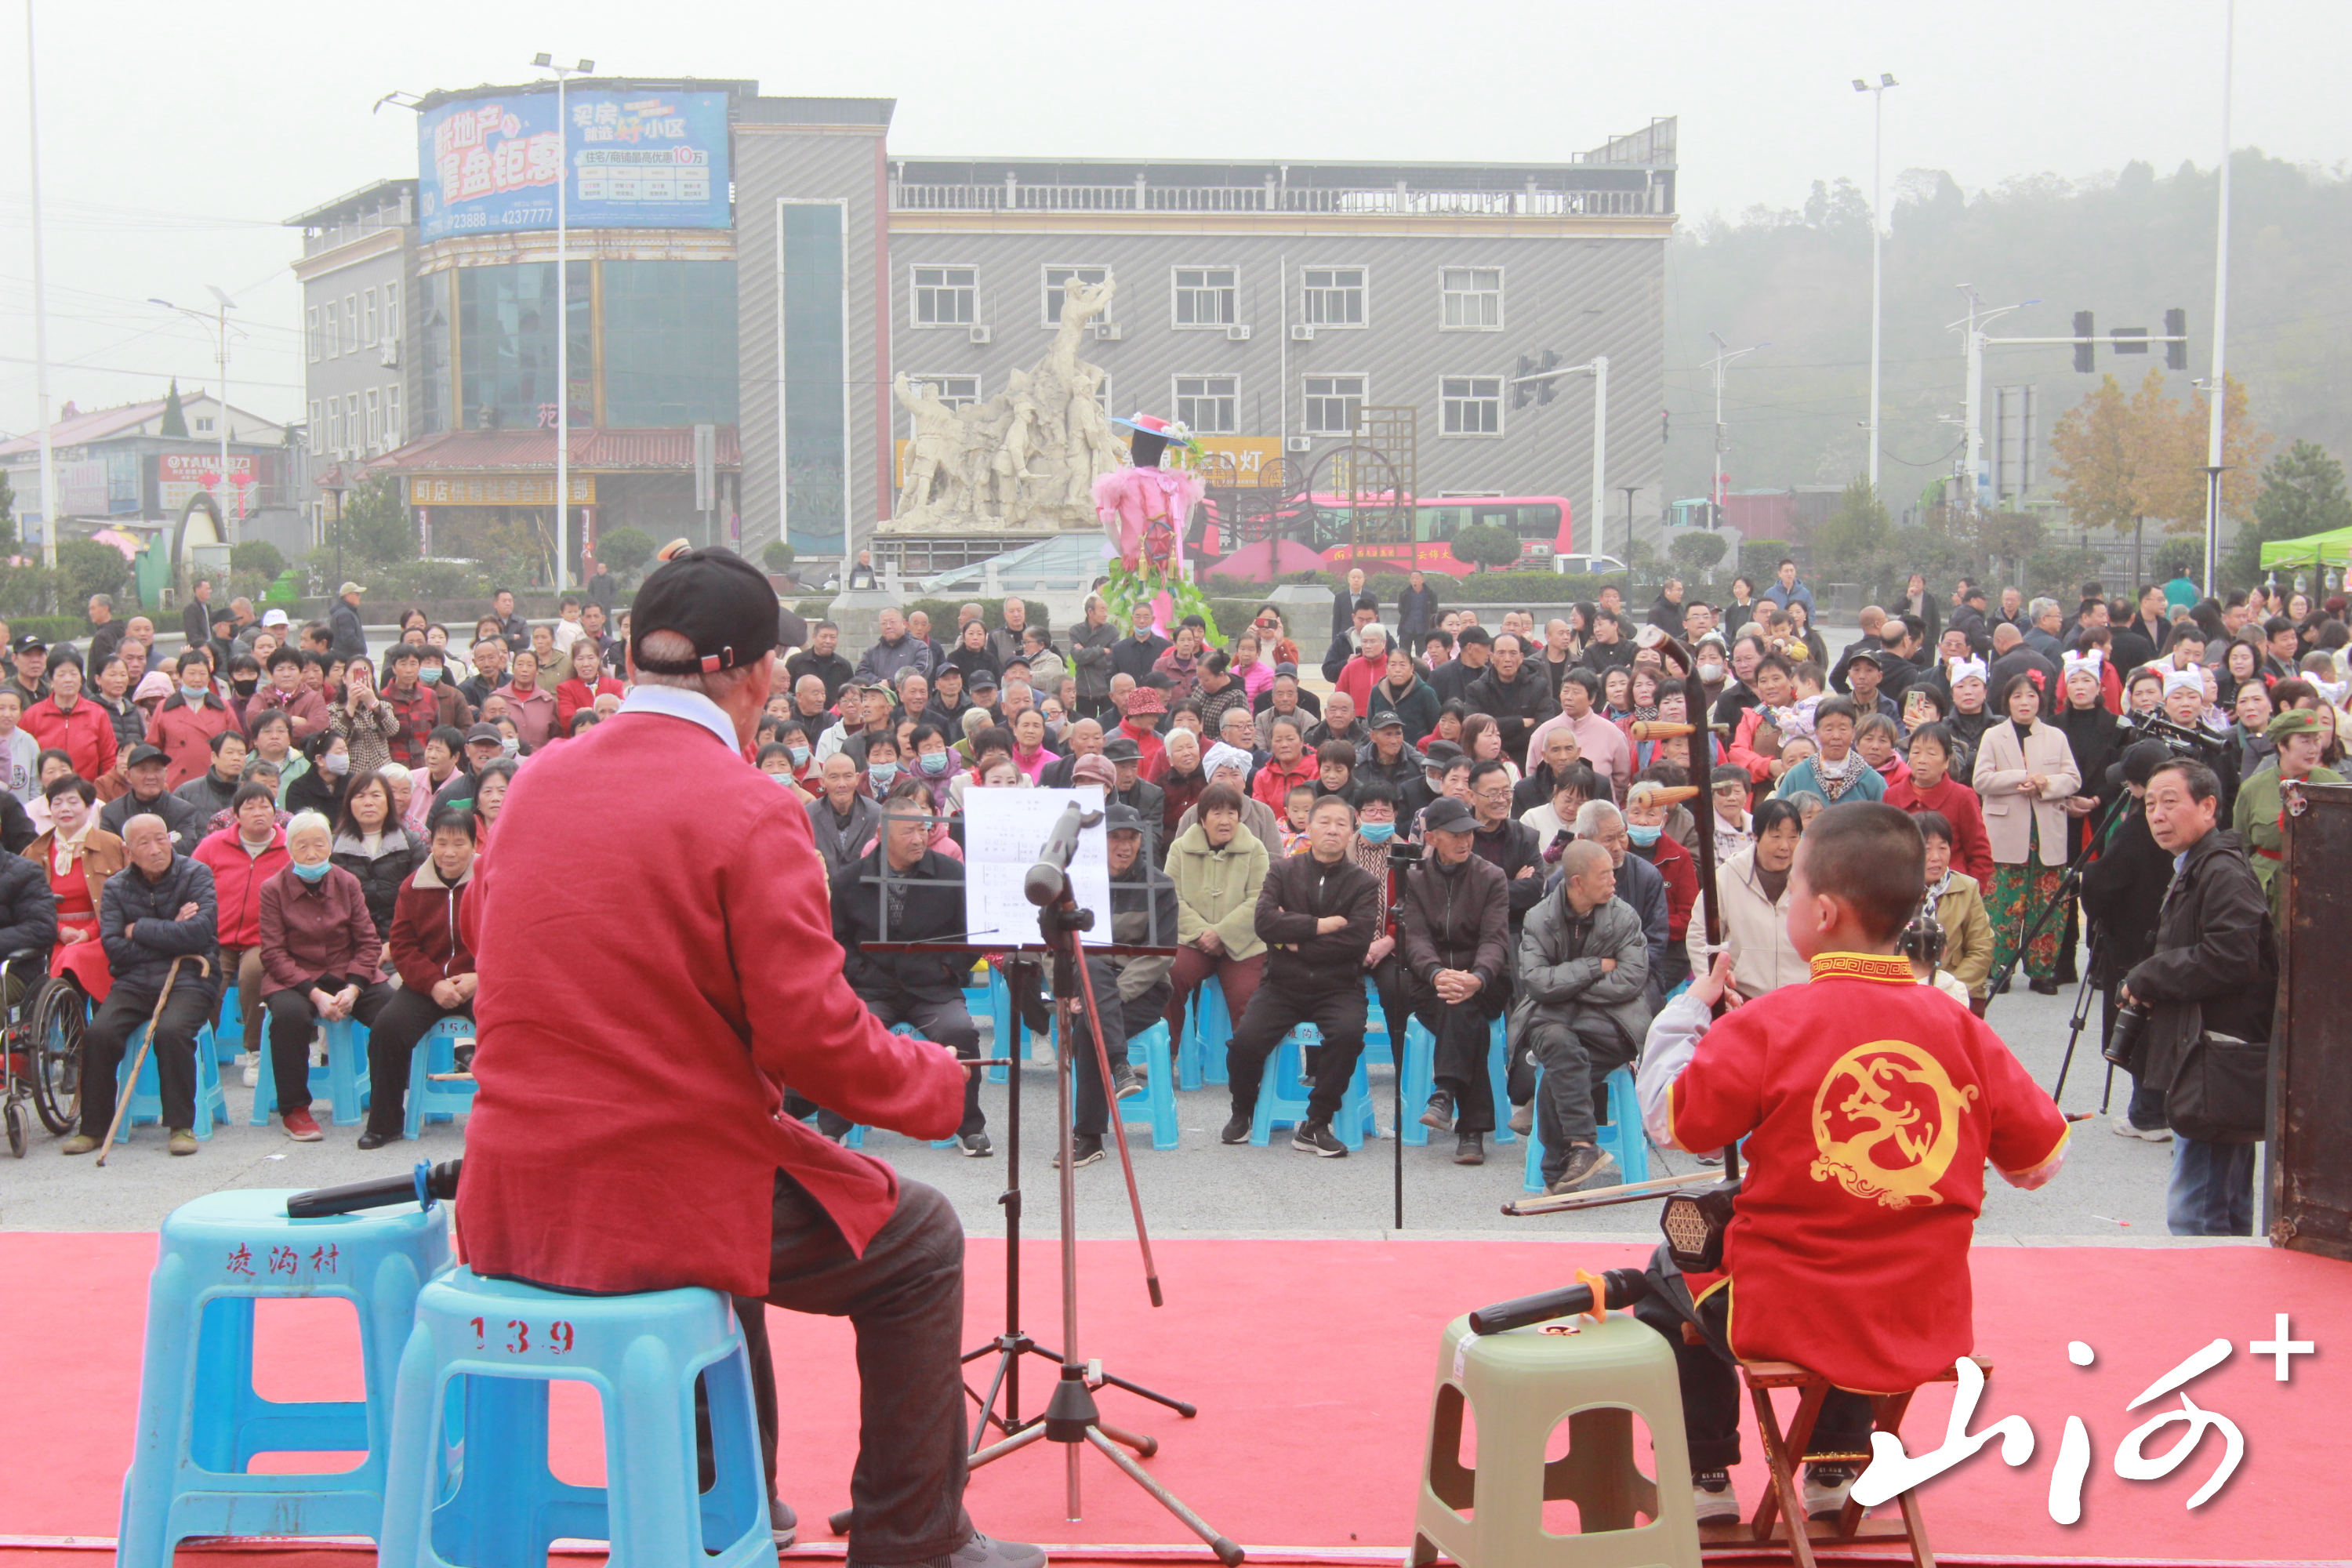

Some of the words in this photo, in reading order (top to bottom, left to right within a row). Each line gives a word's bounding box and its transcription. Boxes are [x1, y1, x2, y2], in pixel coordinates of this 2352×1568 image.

[572, 102, 618, 127] 买房
[584, 116, 686, 143] 就选好小区
[586, 147, 703, 164] 住宅/商铺最高优惠10万
[502, 208, 554, 225] 4237777
[537, 403, 560, 429] 苑
[440, 1022, 469, 1033] 154
[470, 1316, 574, 1354] 139
